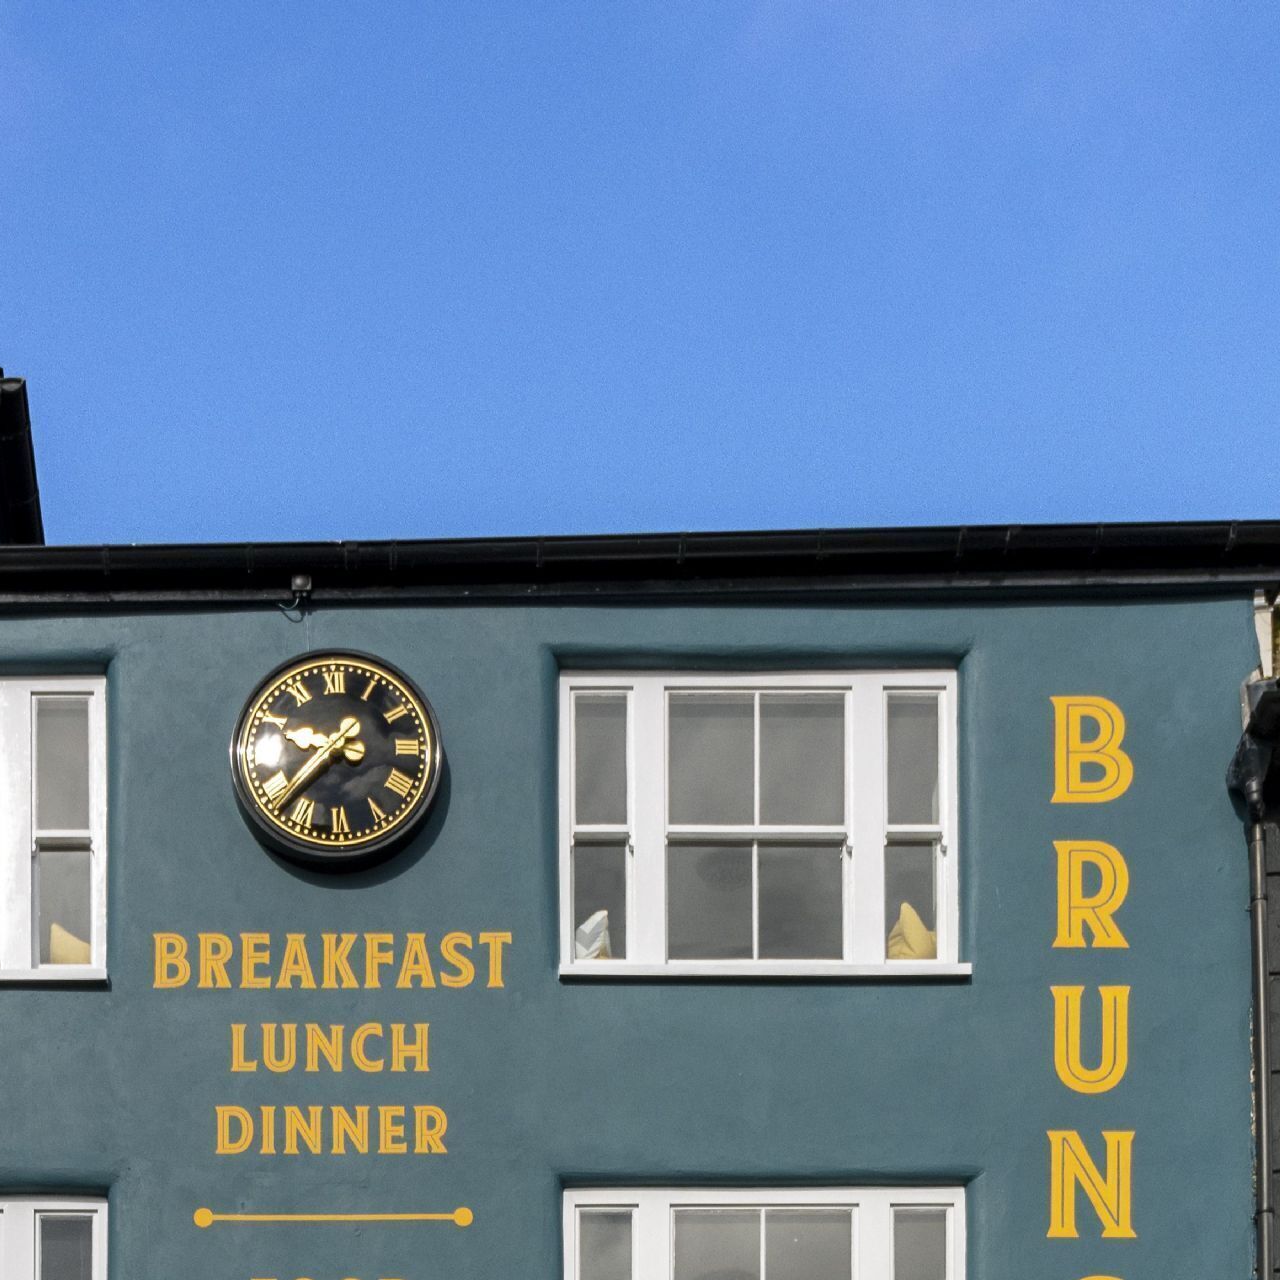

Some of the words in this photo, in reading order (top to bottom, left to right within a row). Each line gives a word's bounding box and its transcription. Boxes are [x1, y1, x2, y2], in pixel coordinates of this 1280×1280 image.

[153, 931, 512, 990] BREAKFAST
[230, 1022, 430, 1073] LUNCH
[215, 1104, 449, 1155] DINNER
